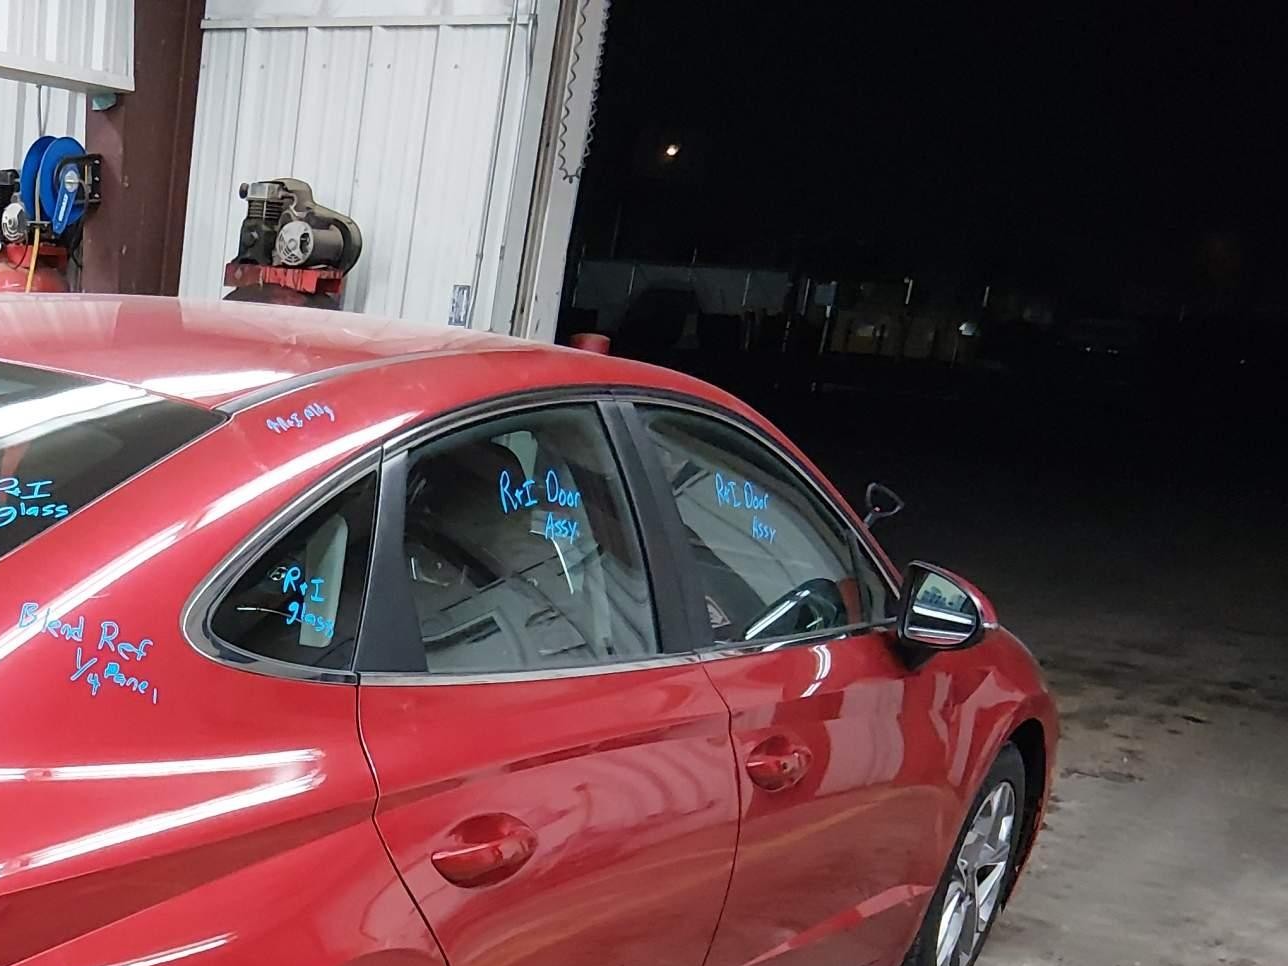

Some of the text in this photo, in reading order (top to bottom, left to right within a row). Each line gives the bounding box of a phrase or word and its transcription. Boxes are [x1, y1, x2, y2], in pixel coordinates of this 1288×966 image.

[545, 469, 582, 509] Door
[743, 481, 769, 510] Door
[17, 601, 154, 661] Blend Ref
[70, 646, 158, 705] 1/4 Panel
